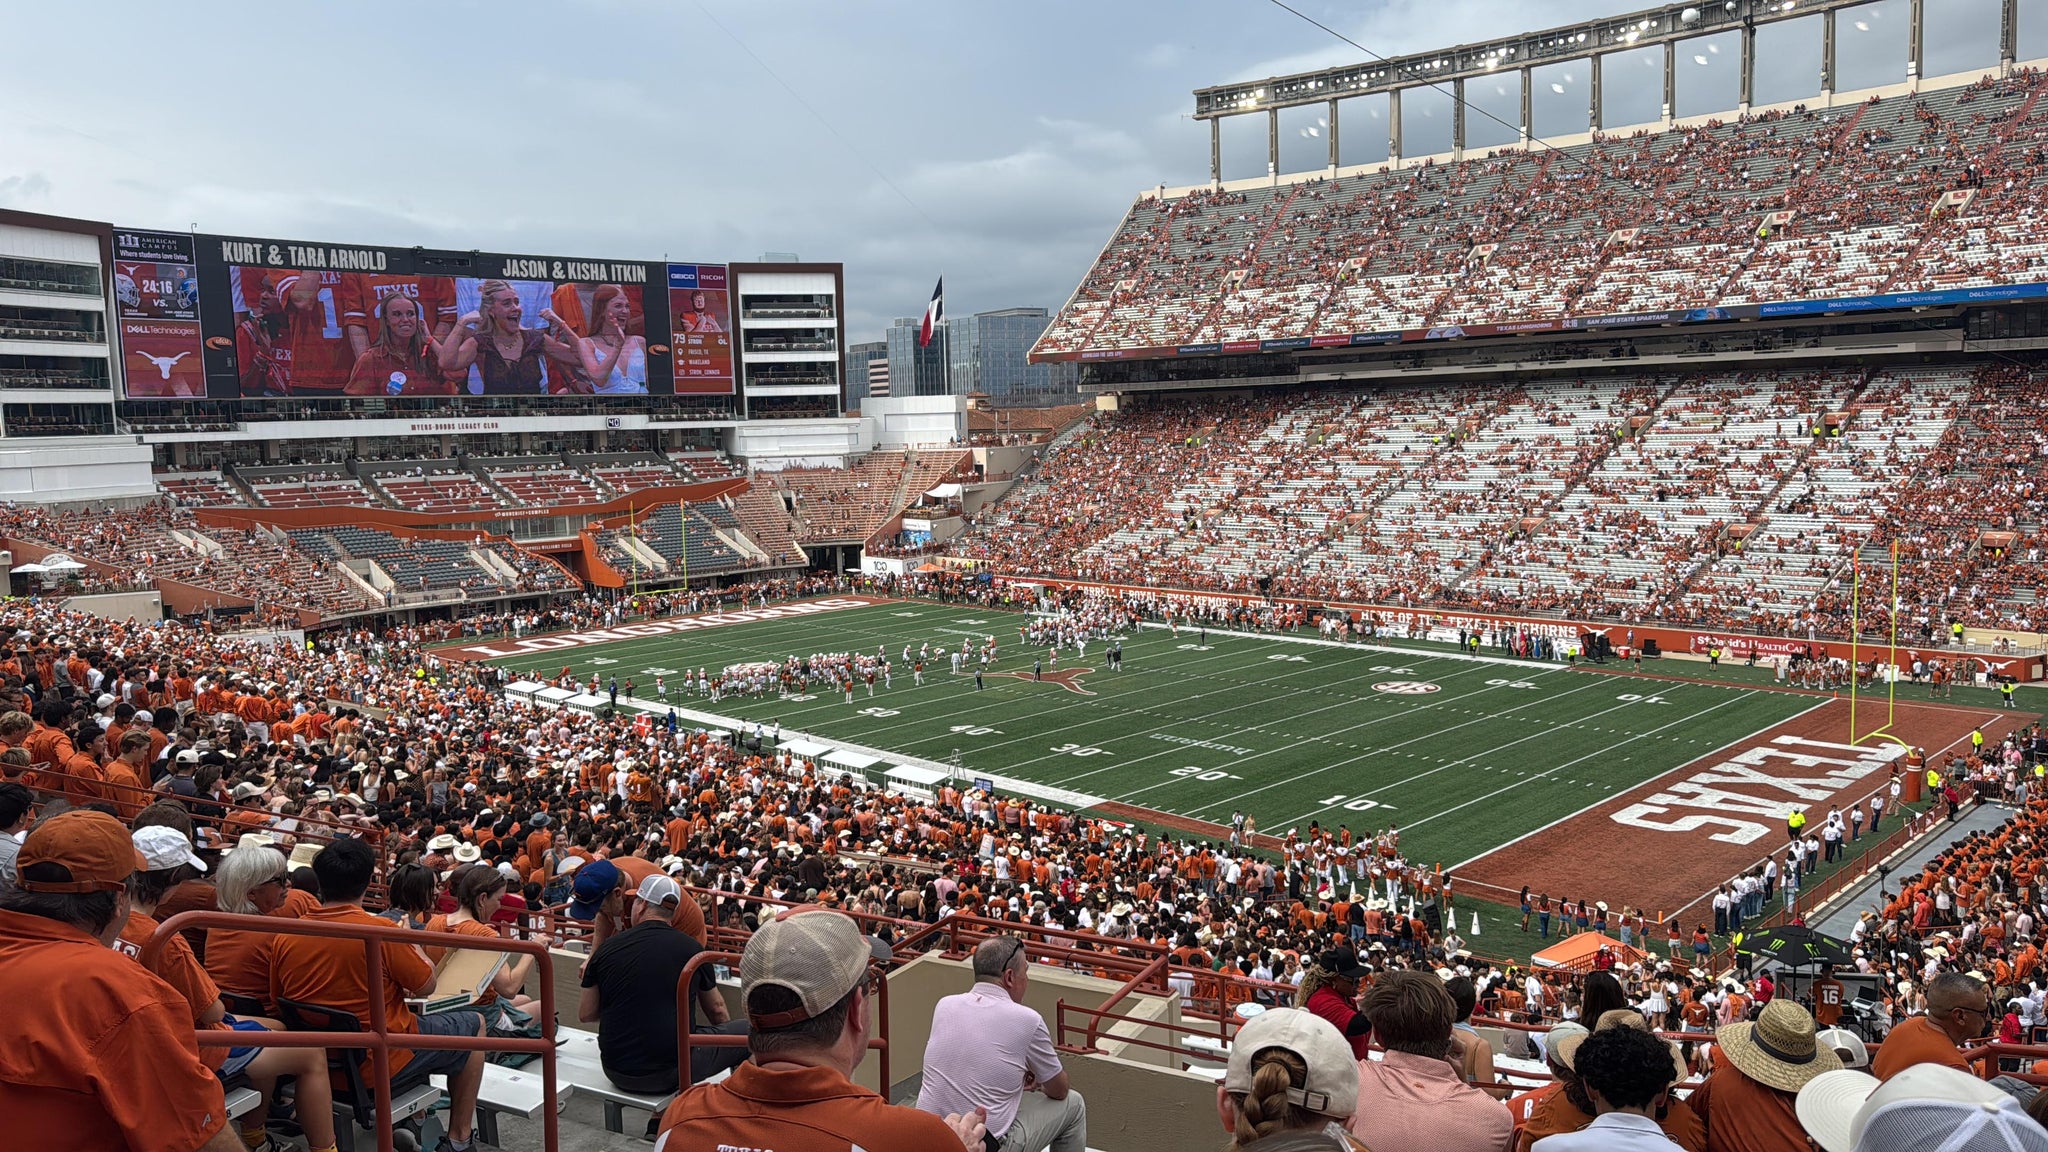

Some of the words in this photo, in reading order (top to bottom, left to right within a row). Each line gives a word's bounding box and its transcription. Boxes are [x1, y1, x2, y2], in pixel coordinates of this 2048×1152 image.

[120, 250, 138, 258] Where
[138, 251, 161, 259] students
[222, 241, 263, 265] KURT
[267, 245, 283, 266] &
[288, 246, 326, 268] TARA
[329, 248, 387, 270] ARNOLD
[502, 259, 547, 279] JASON
[552, 261, 566, 280] &
[568, 262, 608, 282] KISHA
[611, 264, 646, 282] ITKIN
[142, 280, 172, 294] 24:16
[317, 287, 344, 339] 1
[1616, 315, 1636, 323] STATE
[1636, 314, 1669, 322] SPARTANS
[127, 325, 150, 334] DELL
[150, 326, 196, 336] Technologies
[1516, 322, 1552, 330] LONGHORNS
[674, 334, 686, 344] 79
[1161, 593, 1191, 606] EXAS
[1398, 613, 1414, 624] OF
[461, 598, 870, 658] LONGHORNS
[1712, 638, 1746, 648] Daid's
[856, 707, 901, 718] 50
[950, 724, 994, 736] 40
[1050, 744, 1102, 757] 30
[1168, 766, 1228, 782] 20
[1608, 734, 1915, 846] TEXAS
[1318, 794, 1382, 811] 10
[1822, 990, 1839, 1004] 16
[408, 1102, 418, 1114] 57
